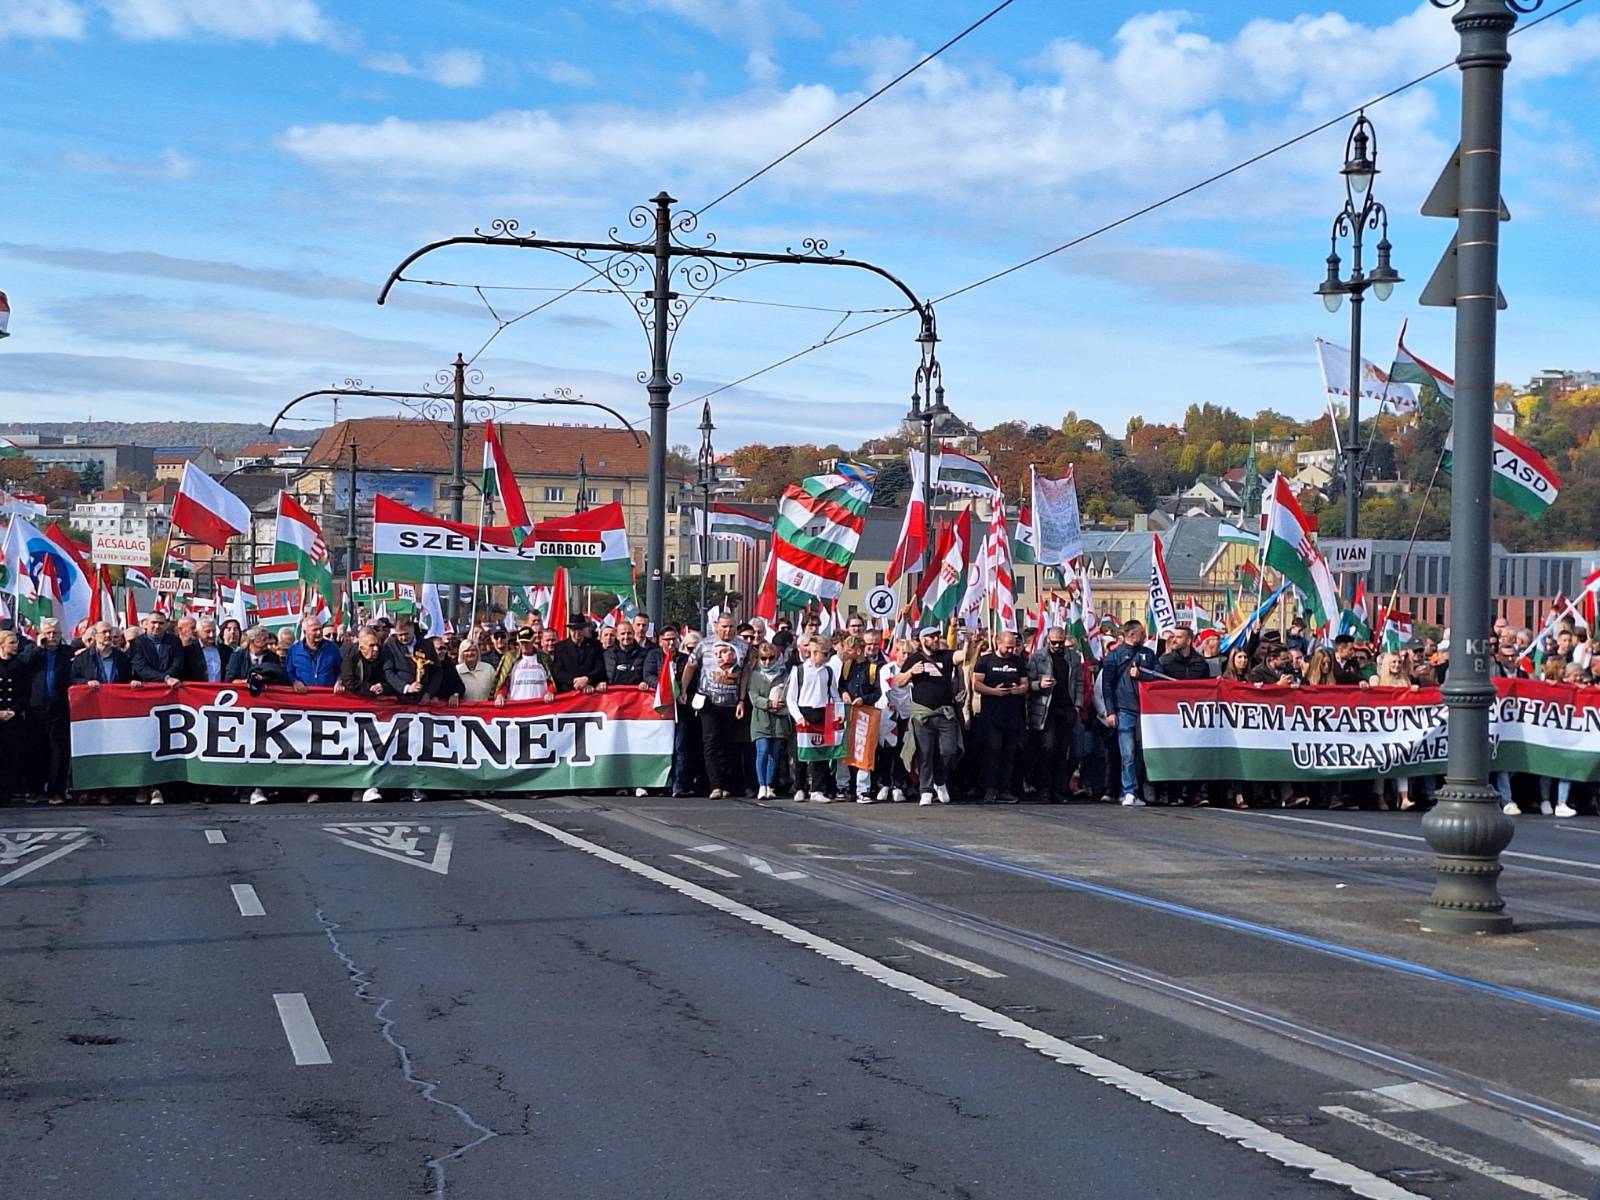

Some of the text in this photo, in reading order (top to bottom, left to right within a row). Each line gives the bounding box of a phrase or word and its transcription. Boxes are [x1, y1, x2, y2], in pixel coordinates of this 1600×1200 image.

[97, 538, 146, 551] ACSALAG
[539, 542, 597, 556] GARBOLC
[1336, 544, 1367, 561] IVÁN
[1290, 705, 1448, 732] AKARUNK
[153, 692, 604, 766] BÉKEMENET
